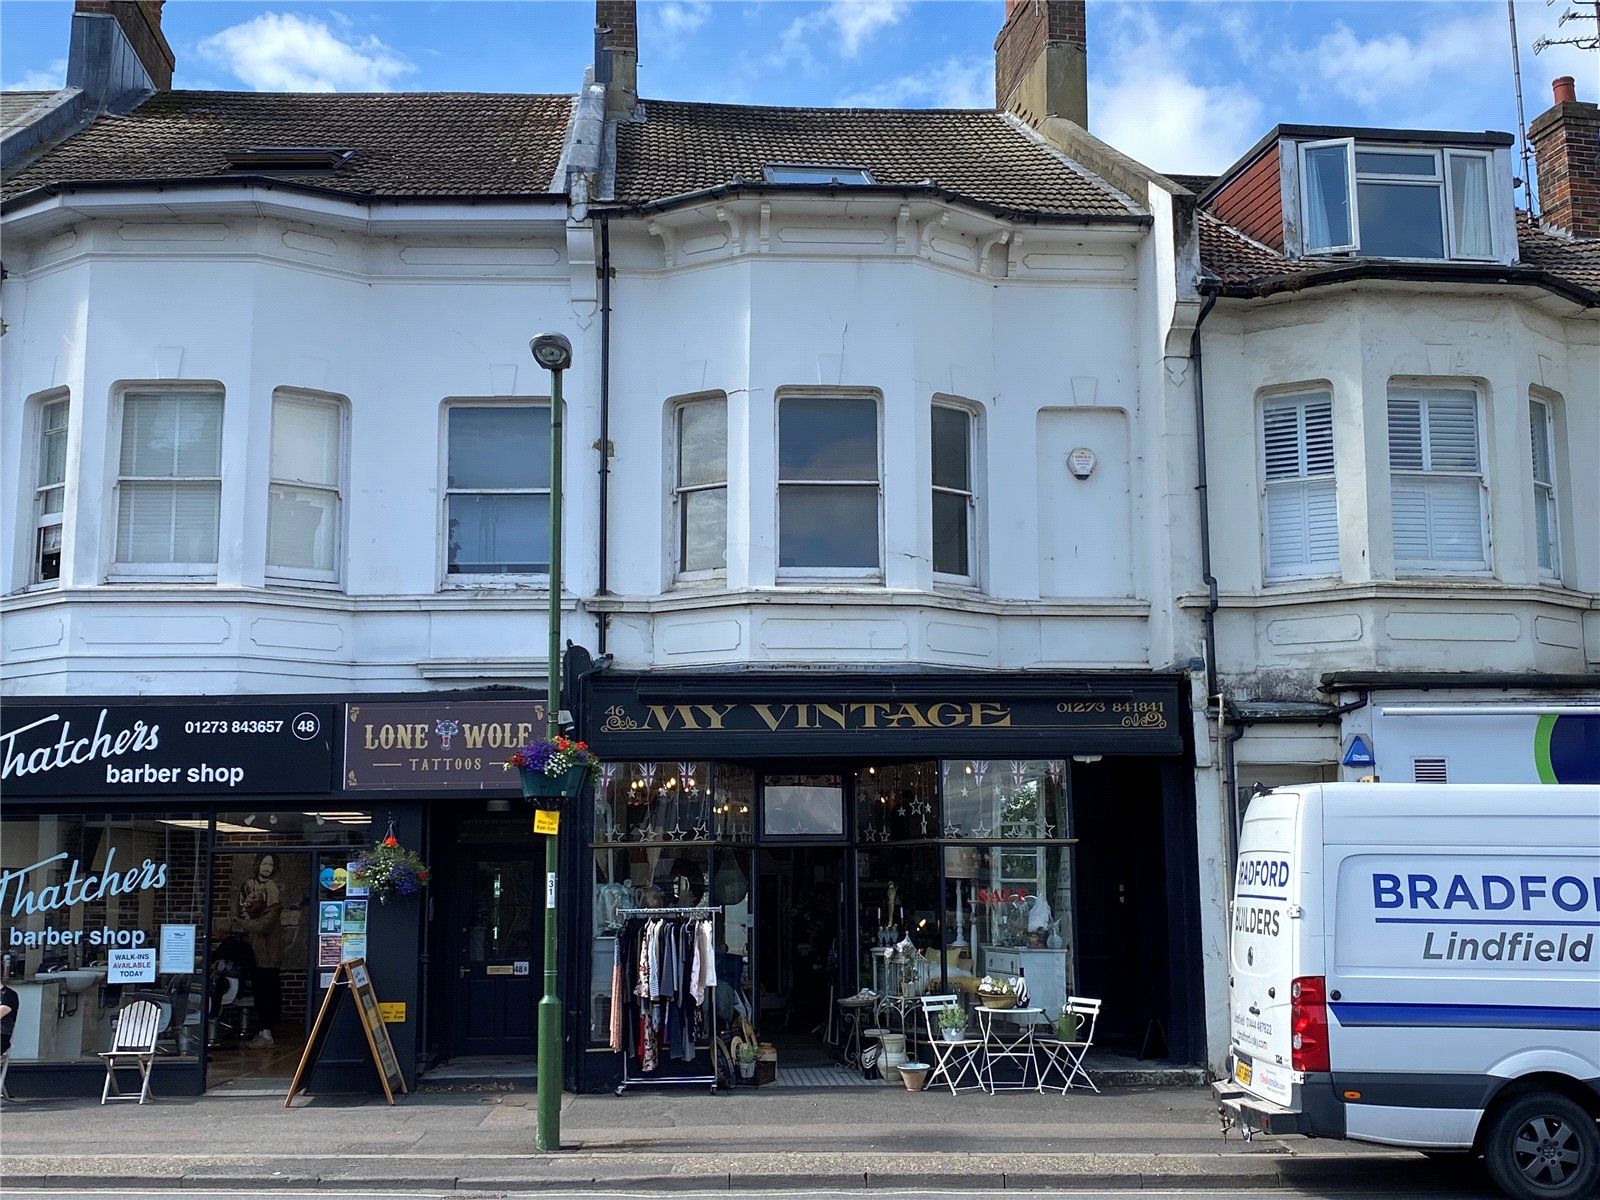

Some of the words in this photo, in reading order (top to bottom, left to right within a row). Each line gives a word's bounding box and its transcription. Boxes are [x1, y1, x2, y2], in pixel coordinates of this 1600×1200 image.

[604, 705, 625, 716] 46
[1056, 702, 1106, 713] 01273
[1112, 701, 1164, 713] 841841
[641, 704, 738, 732] MY
[749, 702, 1011, 732] VINTAGE
[184, 721, 228, 734] 01273
[231, 720, 284, 734] 843657
[296, 720, 315, 733] 48
[364, 723, 429, 750] LONE
[462, 722, 533, 749] WOLF
[408, 758, 482, 771] TATTOOS
[105, 763, 181, 784] barber
[186, 763, 244, 787] shop
[9, 926, 84, 946] barber
[89, 925, 146, 949] shop
[1422, 931, 1594, 962] Lindfield
[114, 953, 150, 961] WALK-INS
[112, 961, 152, 969] AVAILABLE
